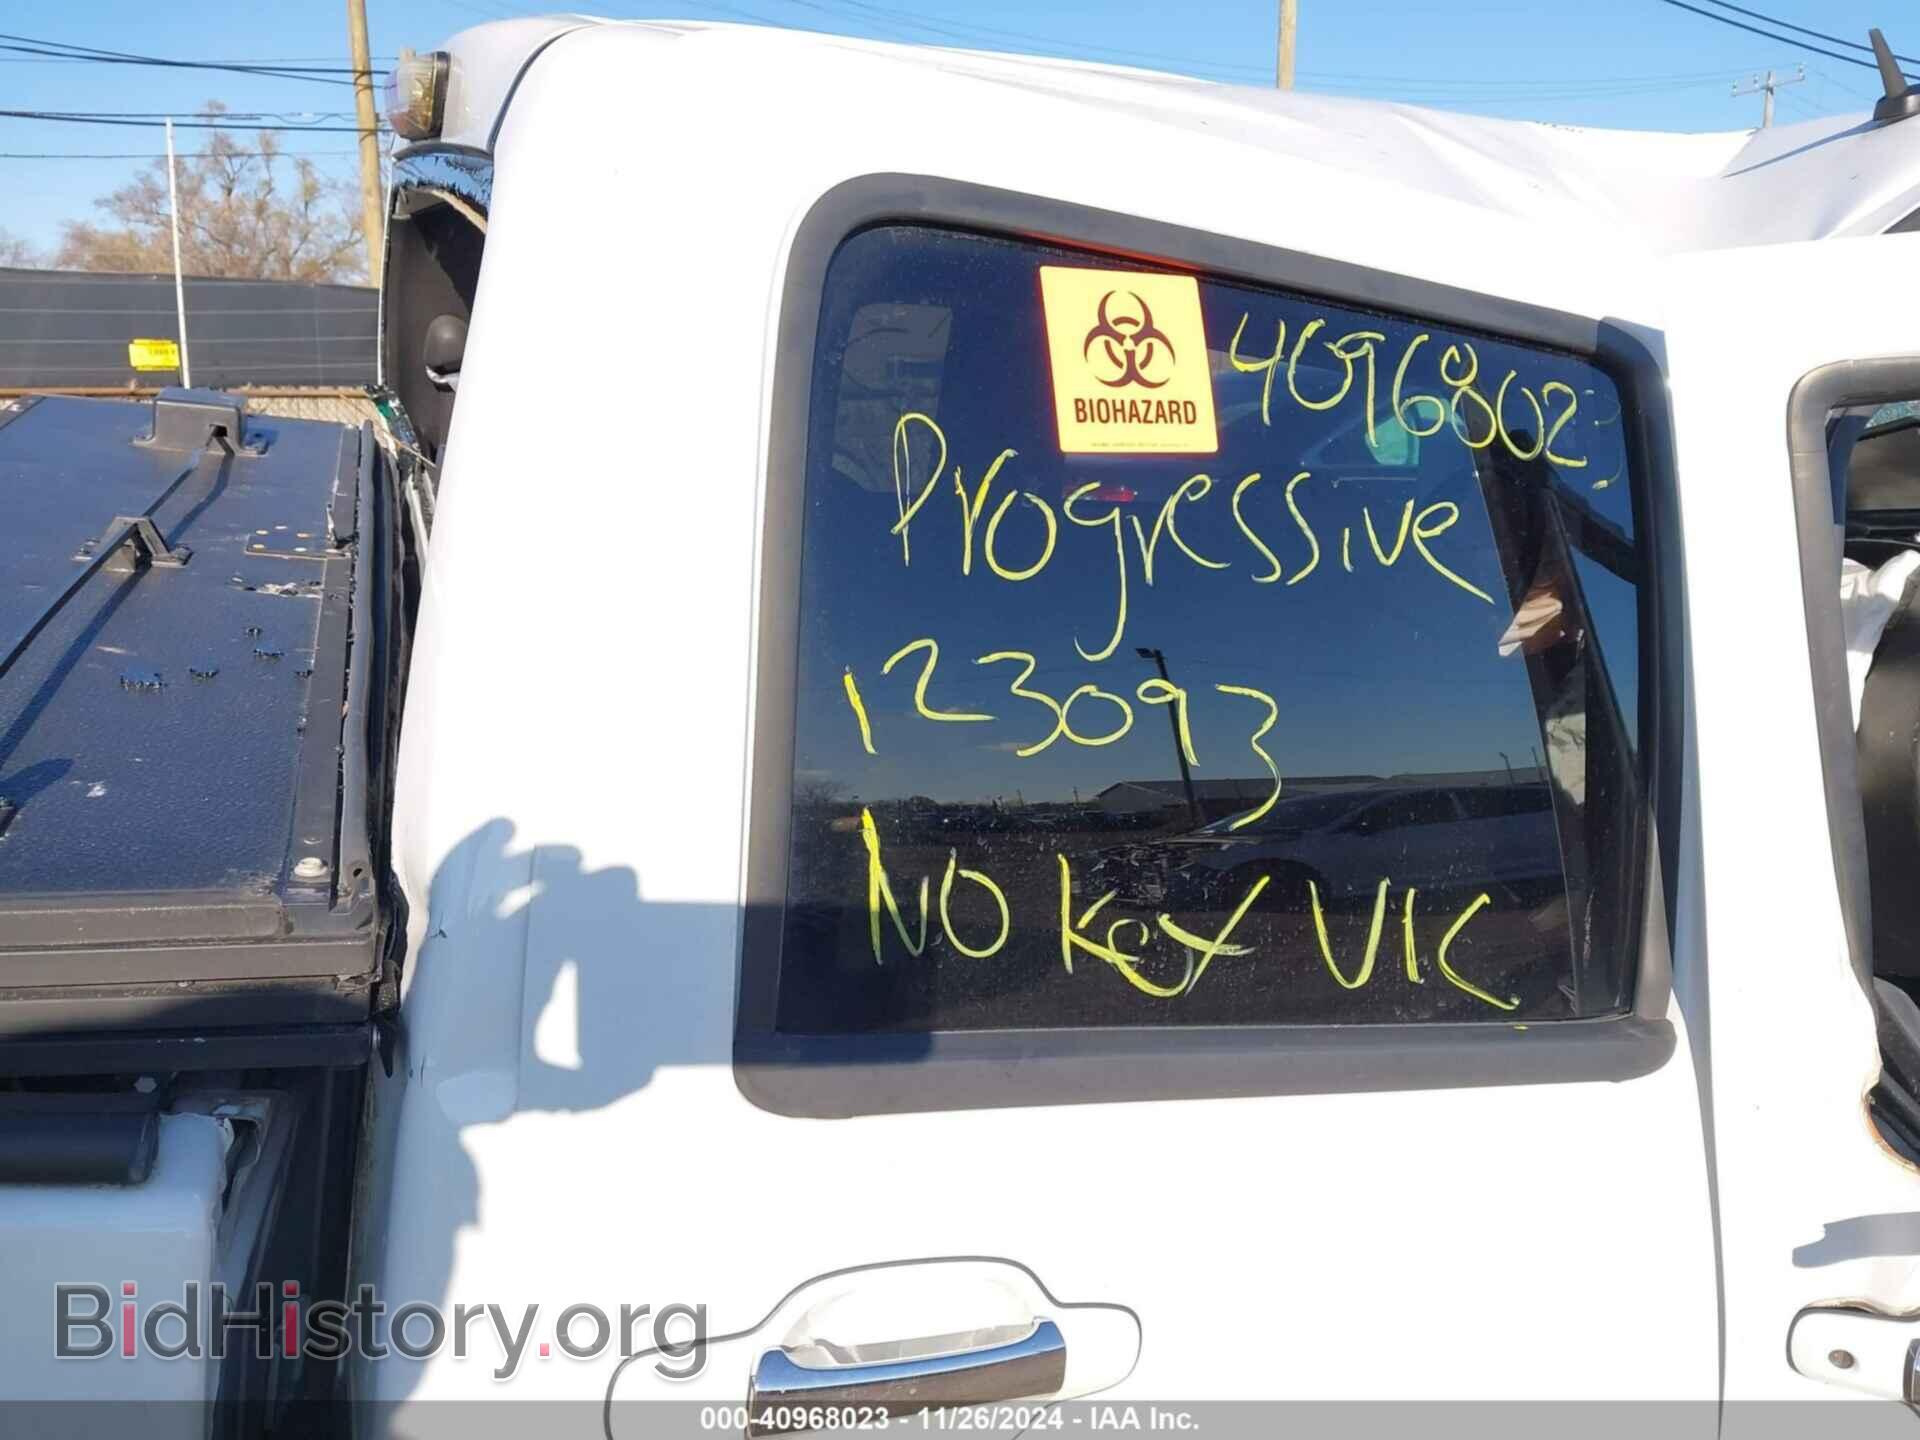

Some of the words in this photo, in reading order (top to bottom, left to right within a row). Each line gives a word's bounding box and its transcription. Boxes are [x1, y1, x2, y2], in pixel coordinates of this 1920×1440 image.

[1074, 398, 1197, 424] BIOHAZARD
[890, 412, 1496, 662] Progressive
[844, 638, 1282, 831] 123093
